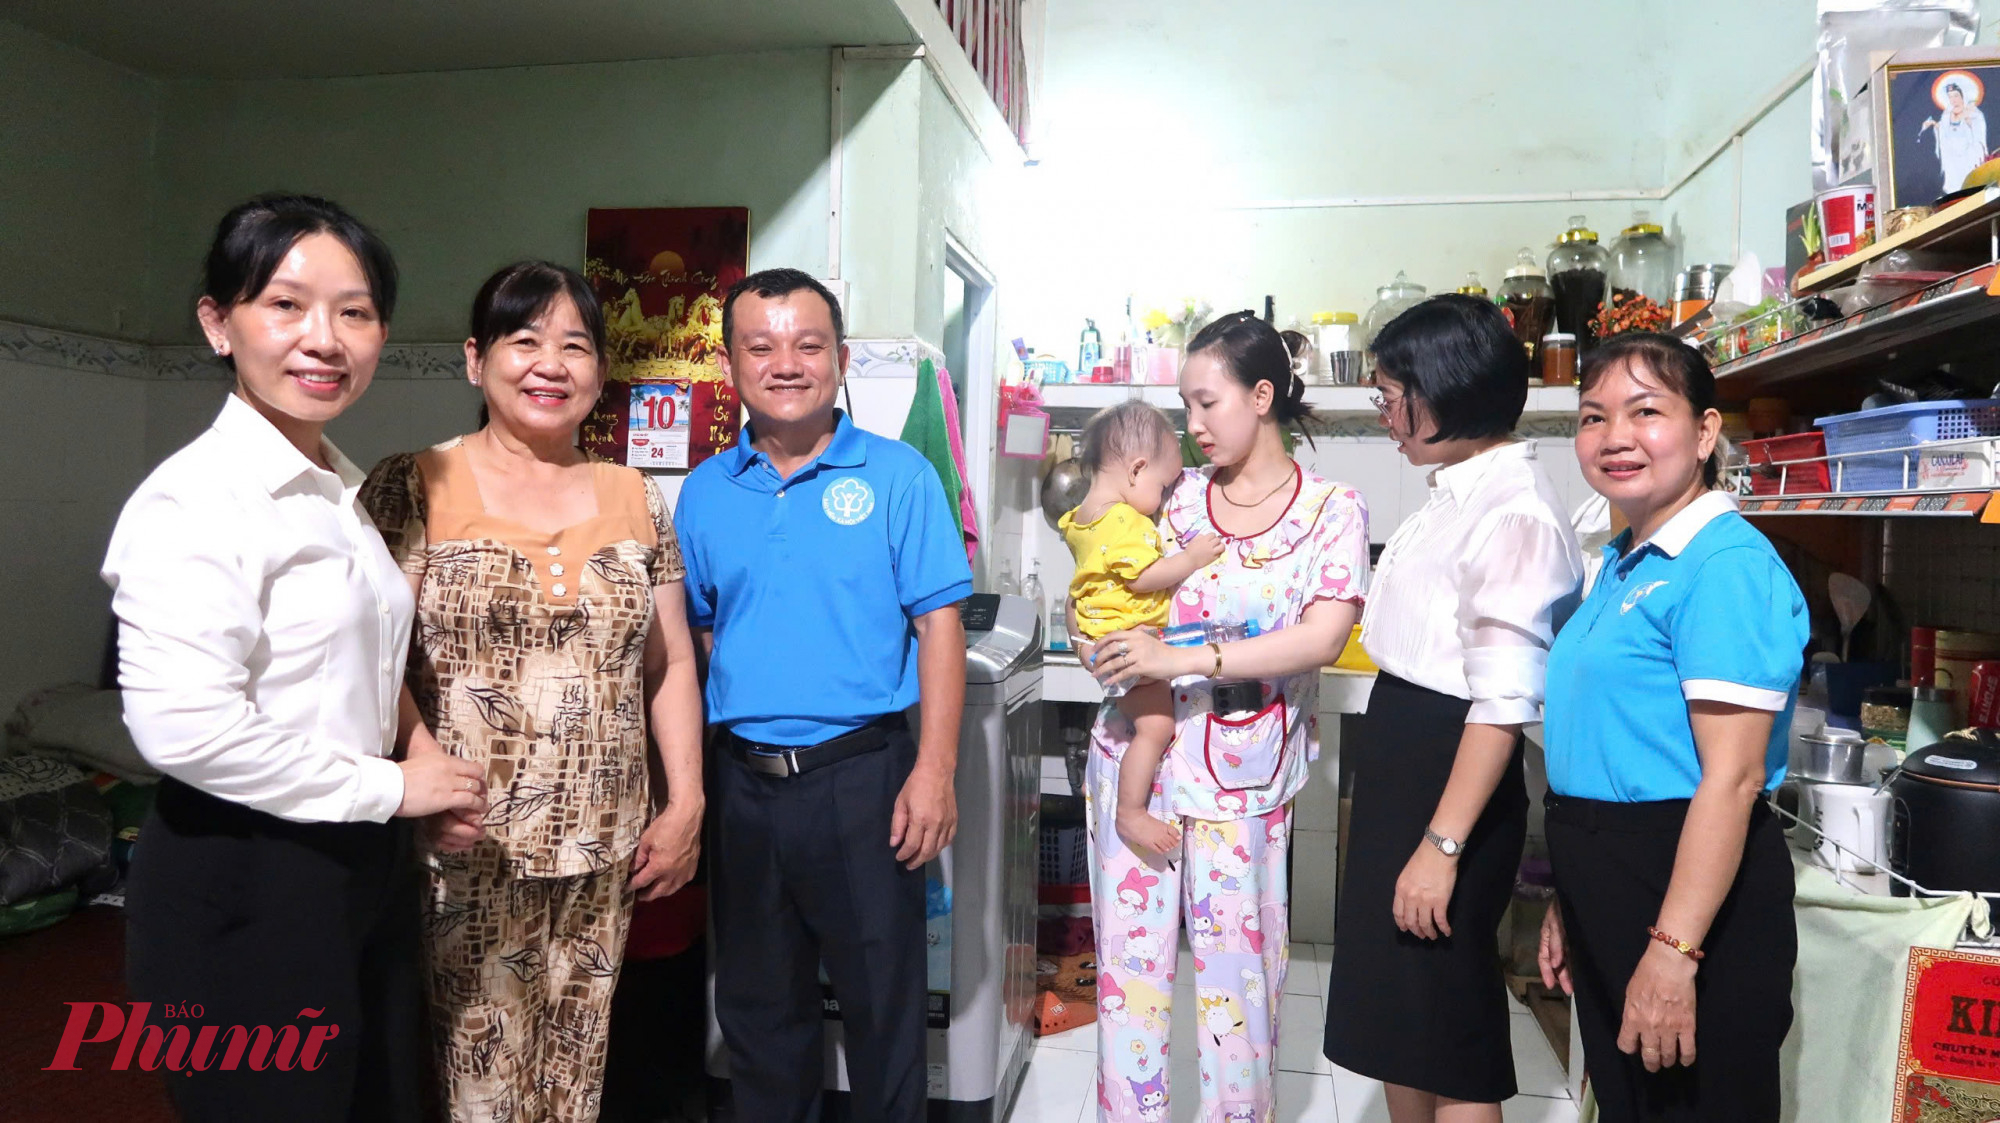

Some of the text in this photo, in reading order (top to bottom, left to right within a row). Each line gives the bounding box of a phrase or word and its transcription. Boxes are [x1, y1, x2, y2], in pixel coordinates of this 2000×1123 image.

[643, 395, 676, 430] 10
[651, 447, 663, 458] 24
[1947, 995, 2000, 1038] KI
